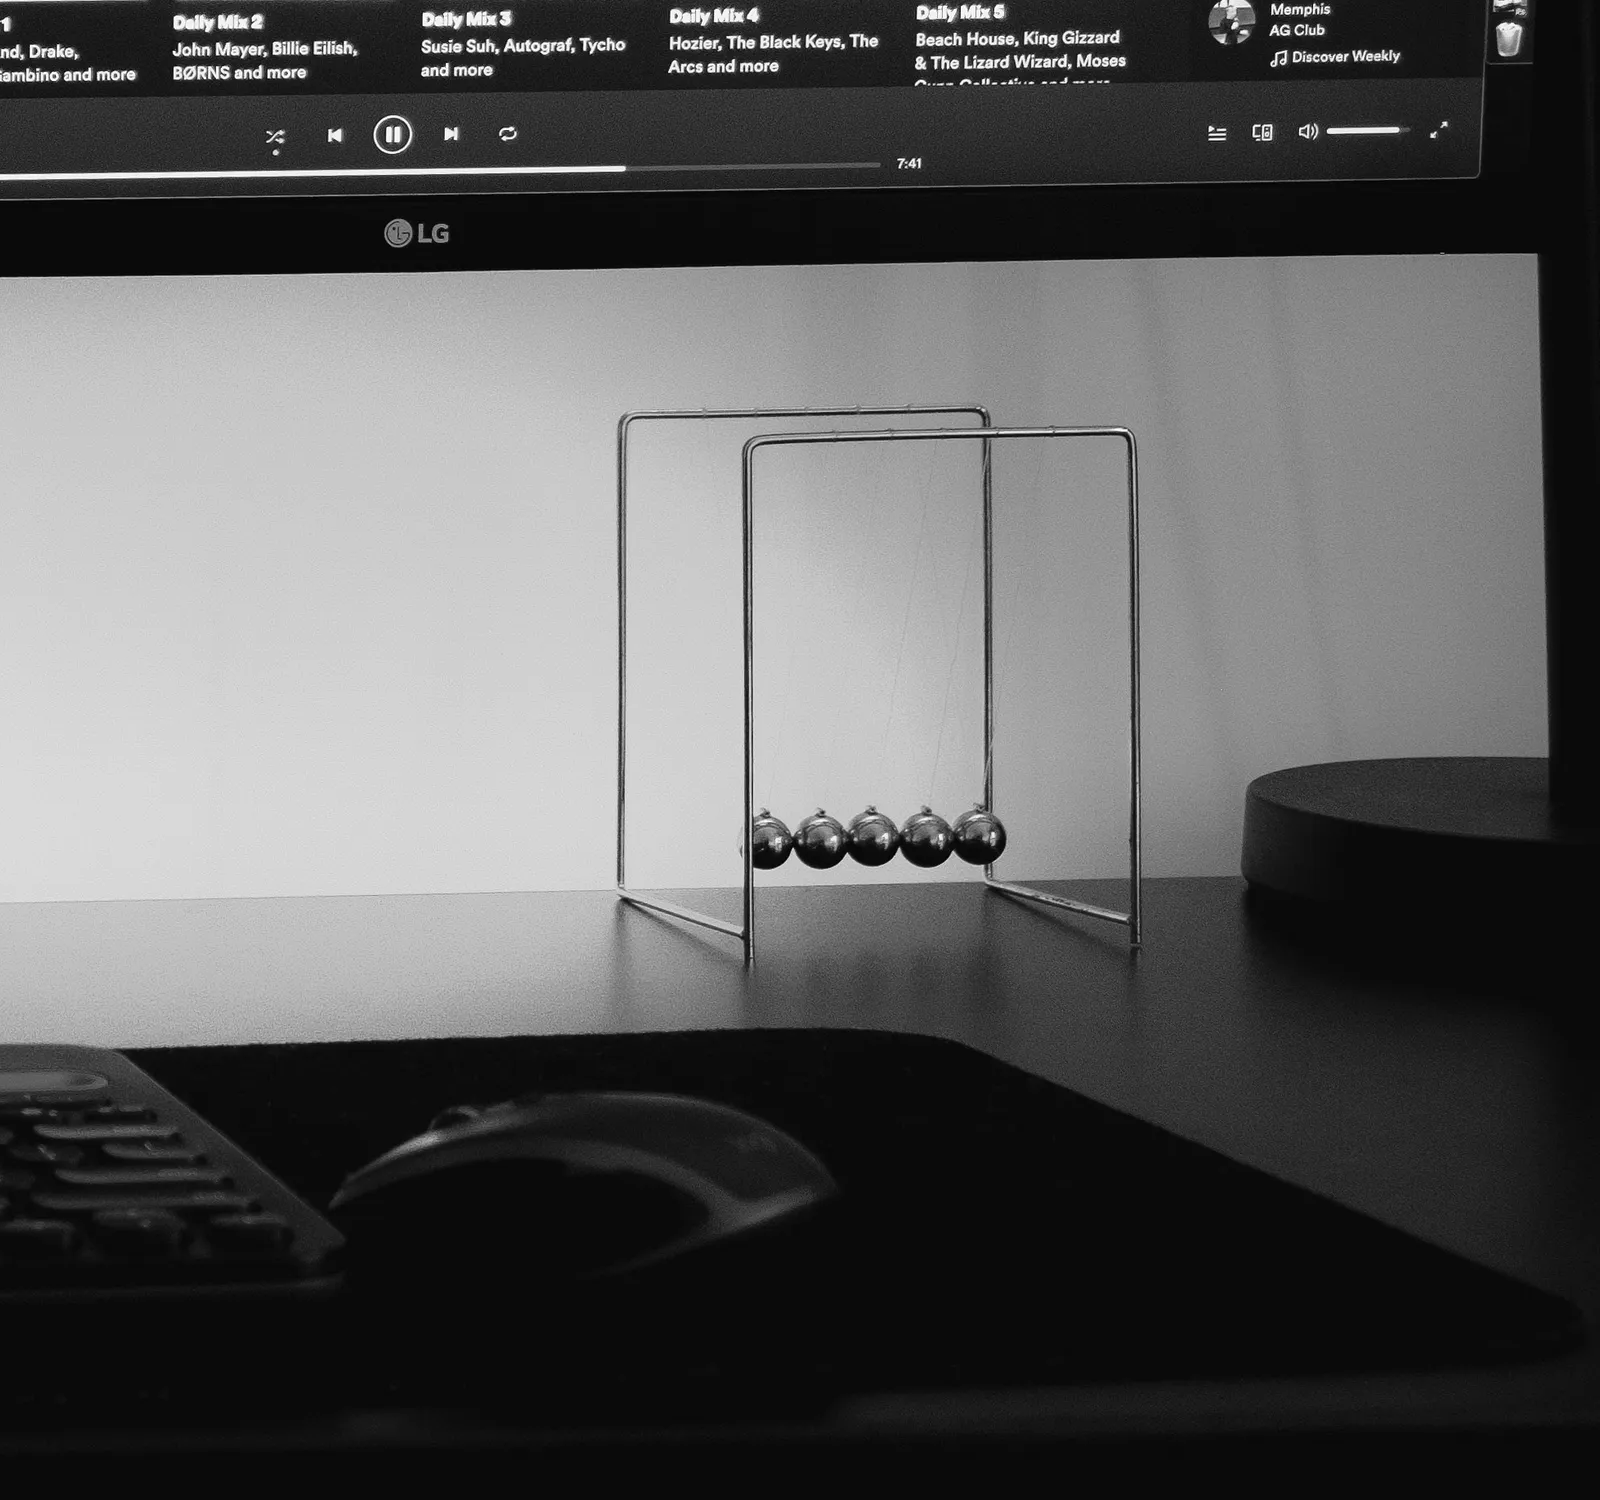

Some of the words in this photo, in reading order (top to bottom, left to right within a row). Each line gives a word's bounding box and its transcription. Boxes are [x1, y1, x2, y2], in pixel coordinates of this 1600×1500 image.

[1271, 3, 1330, 17] Memphis
[64, 68, 92, 81] and
[97, 70, 136, 81] more
[898, 158, 921, 169] 7:41
[418, 224, 449, 243] LG
